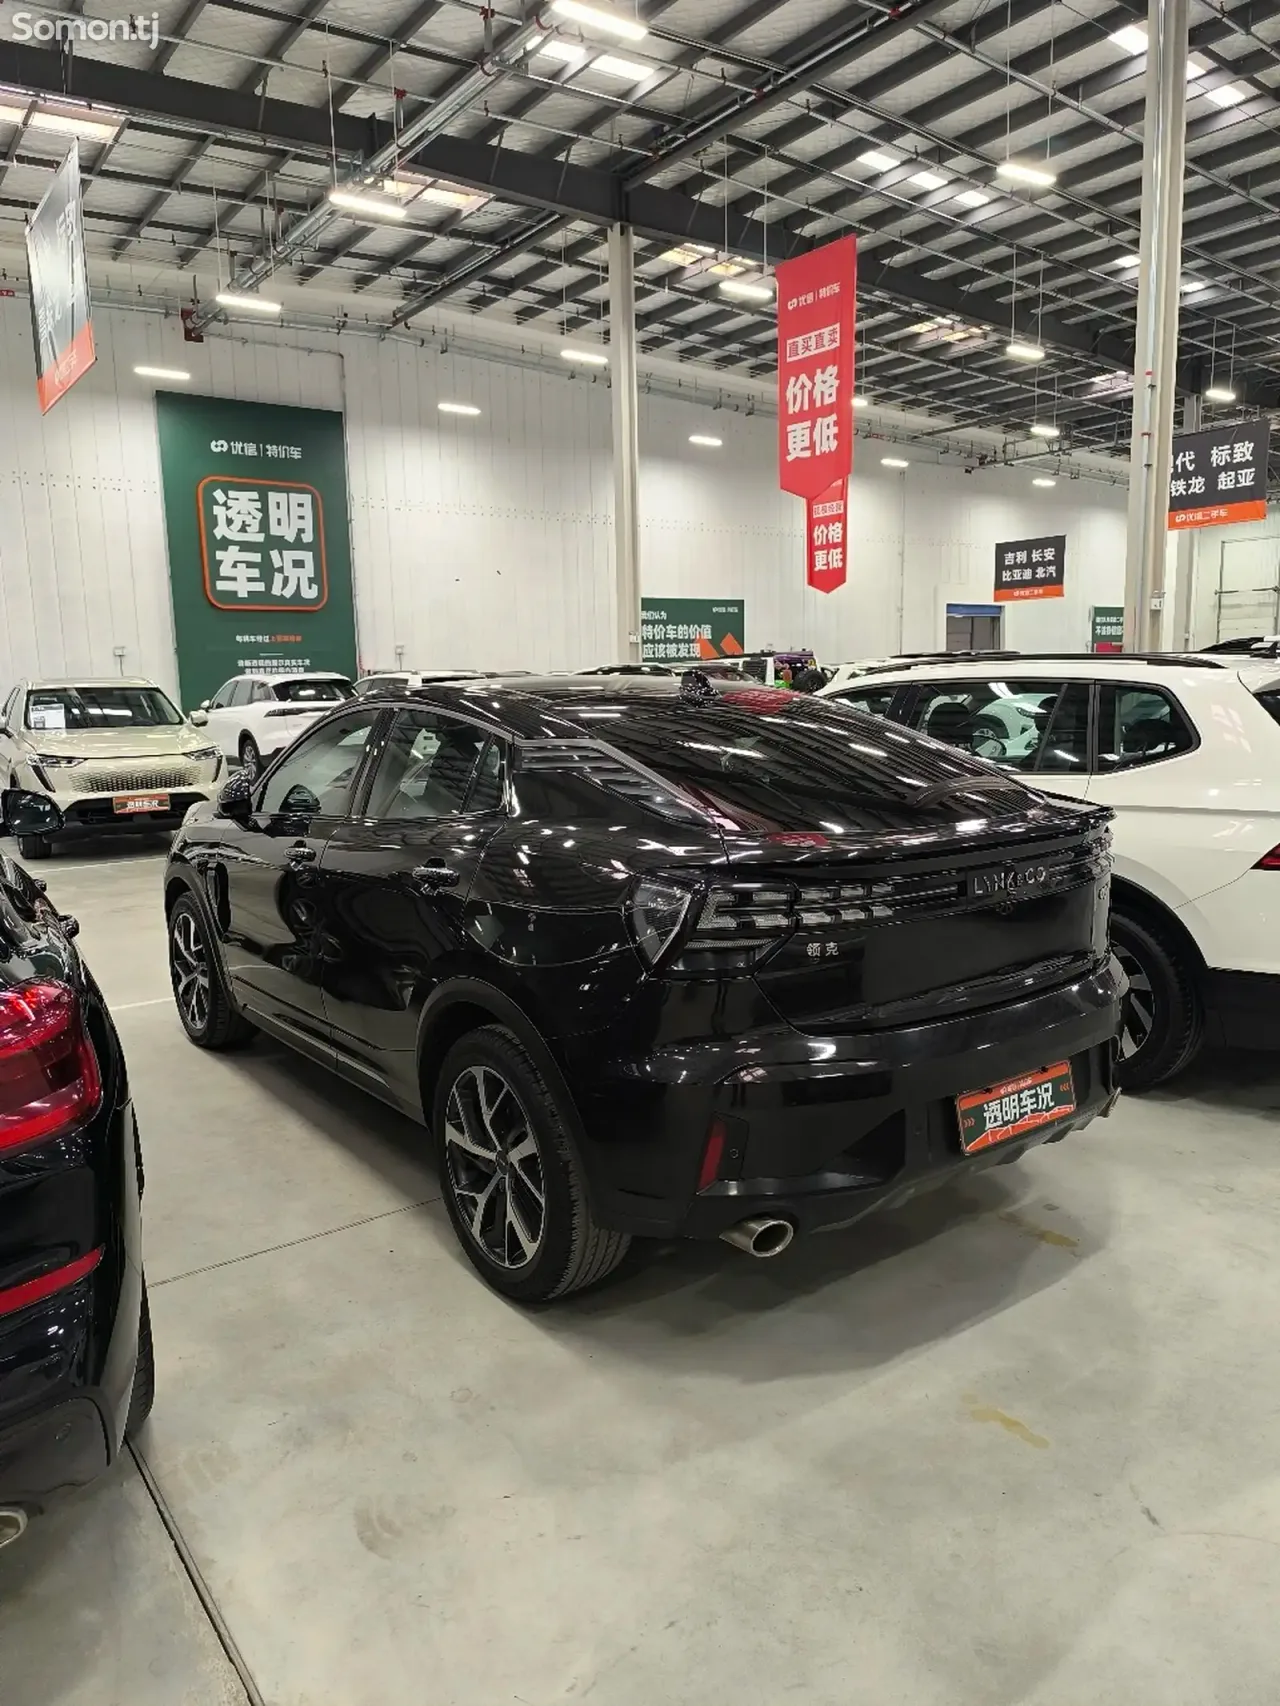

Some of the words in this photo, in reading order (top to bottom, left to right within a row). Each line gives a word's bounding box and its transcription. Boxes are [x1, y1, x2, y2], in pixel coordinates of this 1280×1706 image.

[787, 326, 839, 359] 直买直卖
[785, 364, 840, 415] 价格
[786, 413, 838, 462] 更低
[230, 441, 258, 457] 优信
[265, 444, 302, 460] 特价车
[1210, 440, 1255, 468] 标致
[1217, 467, 1256, 491] 起亚
[212, 488, 314, 543] 透明
[813, 521, 844, 546] 价格
[813, 547, 844, 572] 更低
[1003, 550, 1028, 566] 吉利
[1031, 547, 1056, 563] 长安
[215, 545, 319, 599] 车况
[1002, 567, 1033, 582] 比亚迪
[1035, 565, 1057, 579] 北汽
[642, 624, 713, 640] 特价车的价值
[643, 643, 701, 659] 应该被发现
[983, 1082, 1056, 1131] 透明车况
